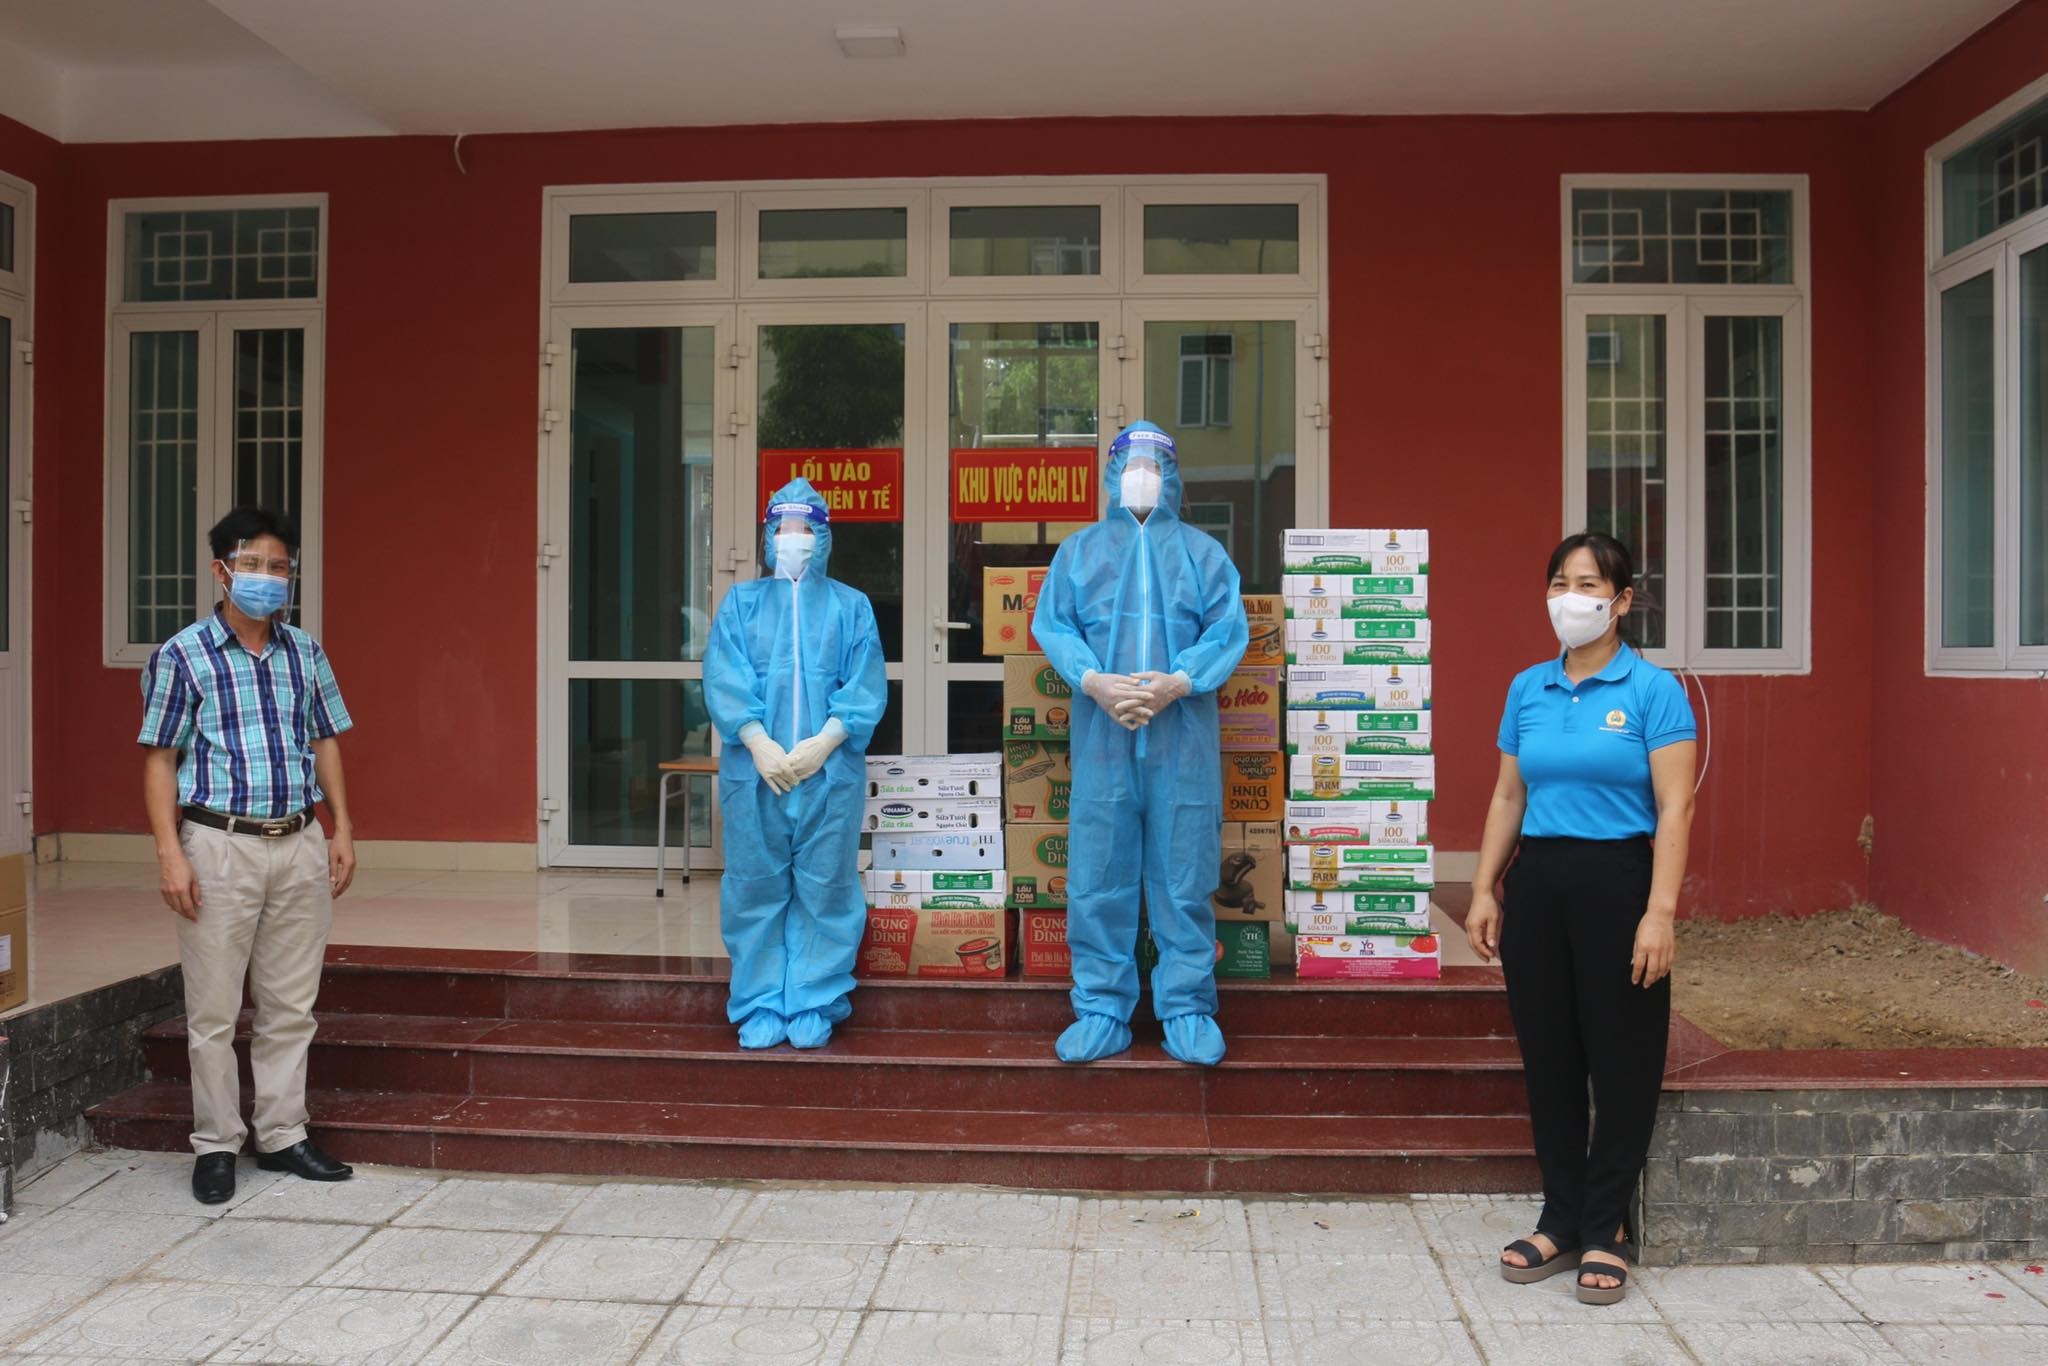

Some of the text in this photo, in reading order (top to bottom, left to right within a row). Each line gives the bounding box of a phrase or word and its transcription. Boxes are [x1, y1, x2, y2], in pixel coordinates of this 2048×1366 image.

[830, 458, 871, 481] VÀO
[960, 458, 1088, 511] KHU VỰC CÁCH LY
[858, 490, 870, 509] Y
[872, 483, 891, 509] TẾ
[1386, 555, 1404, 566] 100
[1310, 598, 1328, 608] 100
[1312, 644, 1330, 654] 100
[1390, 690, 1408, 700] 100
[1314, 735, 1332, 745] 100
[1314, 781, 1340, 790] FARM
[1231, 799, 1269, 811] CUNG
[1384, 827, 1403, 837] 100
[1313, 871, 1338, 881] FARM
[890, 895, 908, 904] 100
[871, 917, 908, 930] CUNG
[1314, 915, 1332, 925] 100
